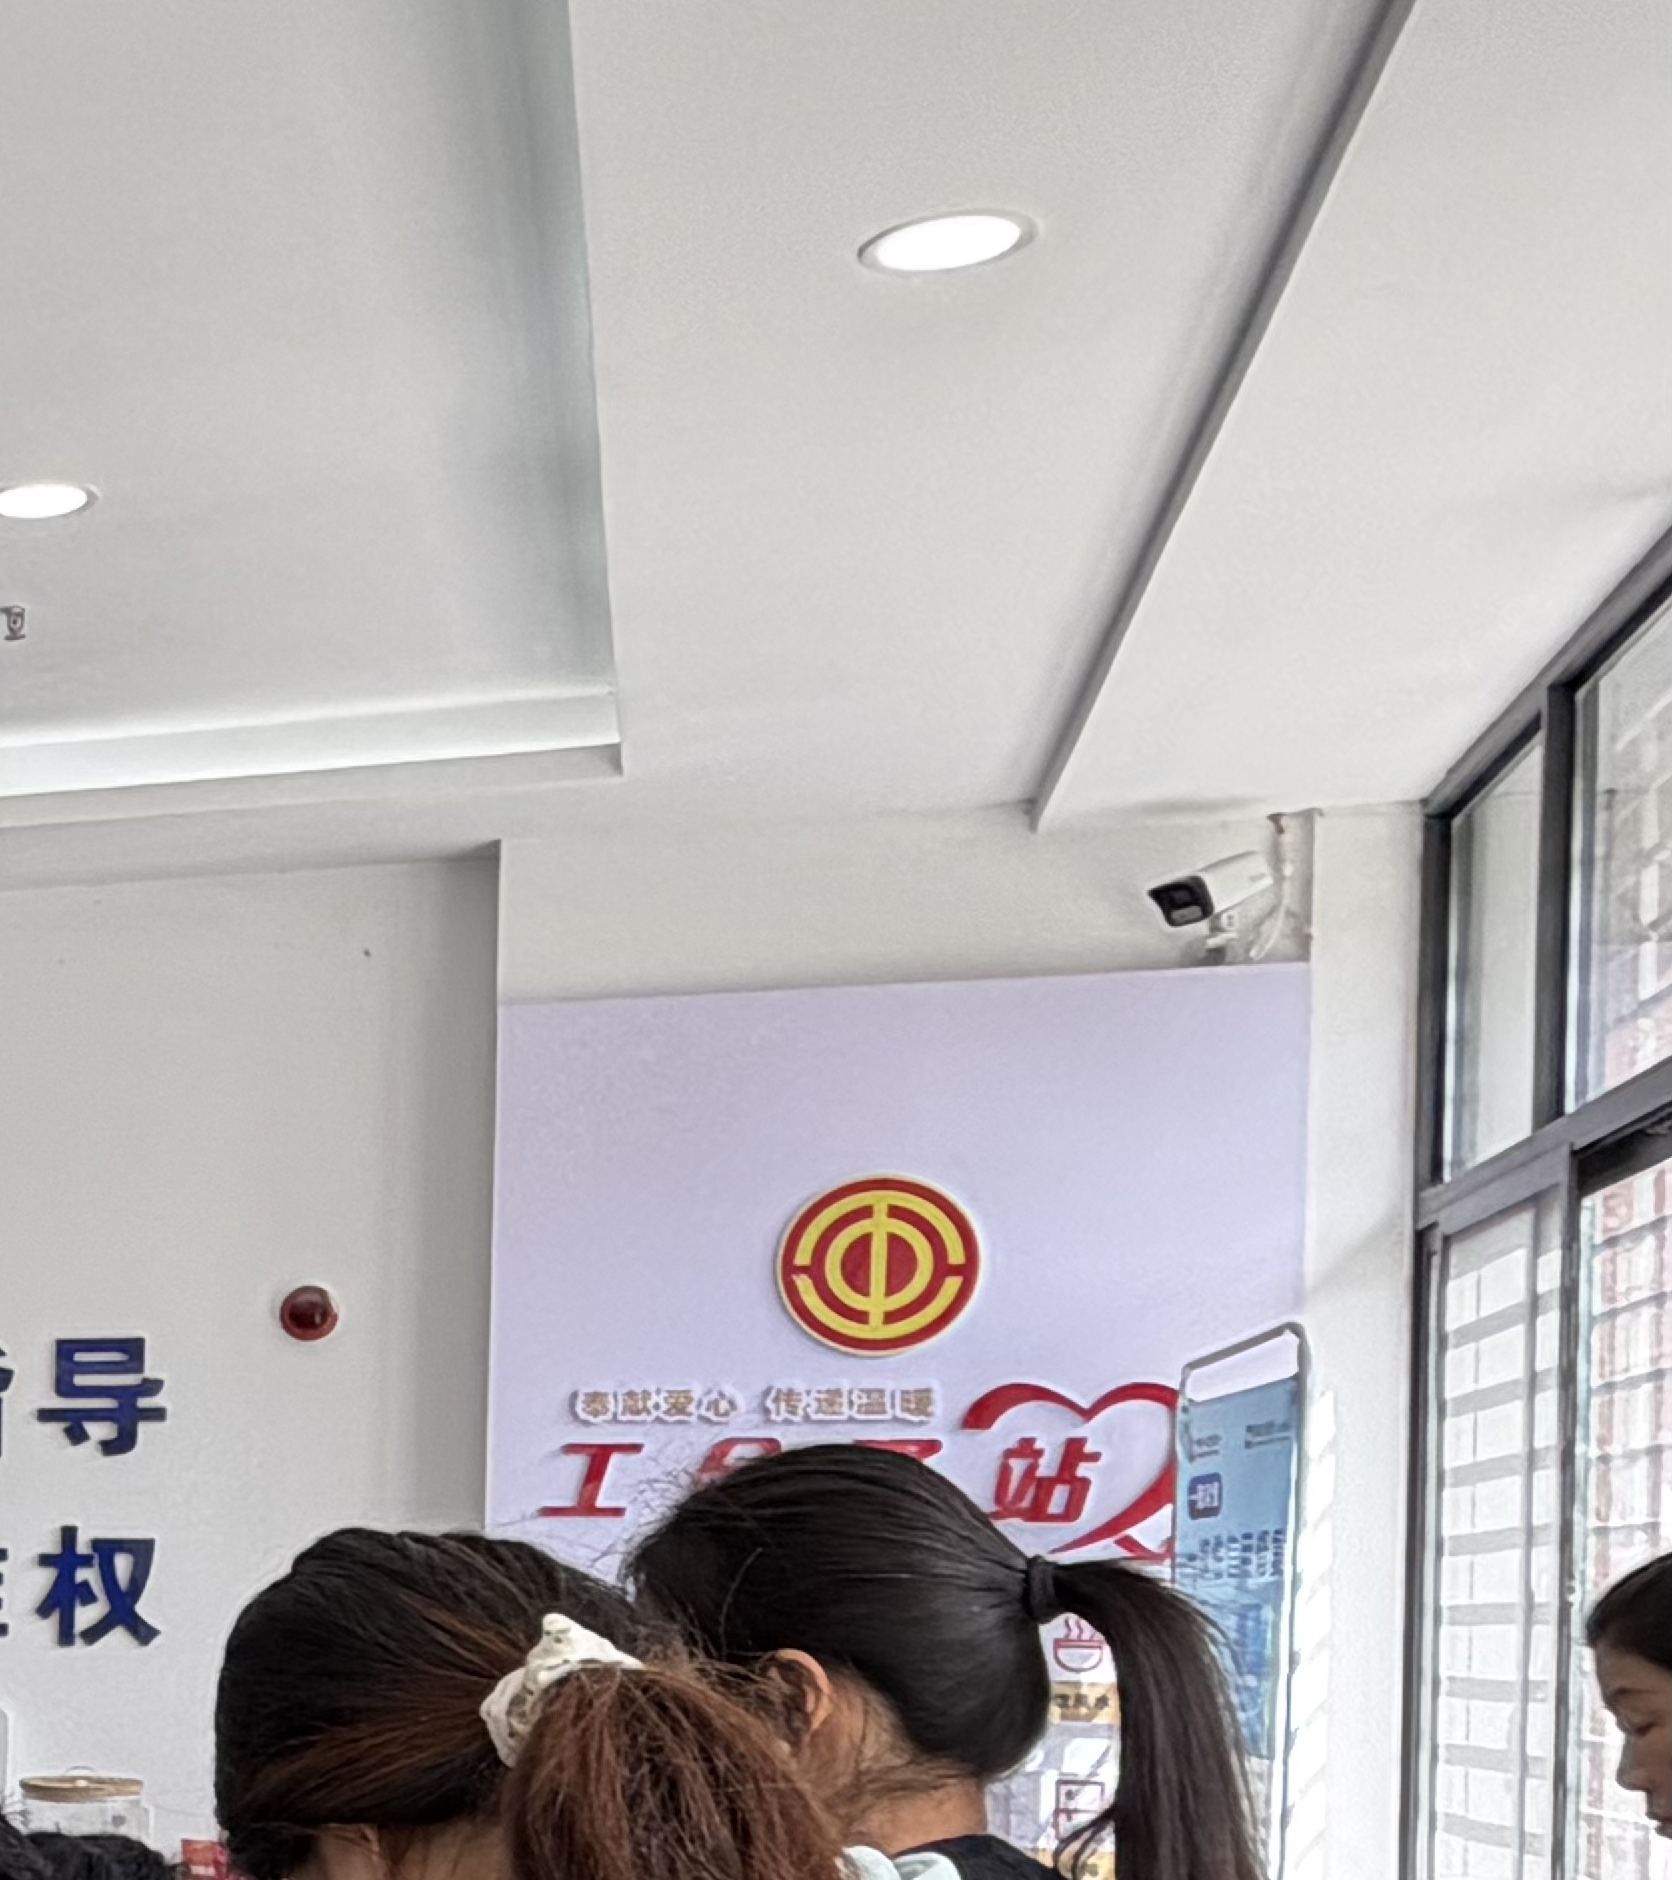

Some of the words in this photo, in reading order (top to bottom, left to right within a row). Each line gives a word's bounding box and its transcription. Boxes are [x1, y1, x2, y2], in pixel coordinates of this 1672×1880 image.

[578, 1387, 738, 1420] 奉献爱心
[766, 1386, 936, 1419] 传递温暖
[539, 1436, 1102, 1524] 工站
